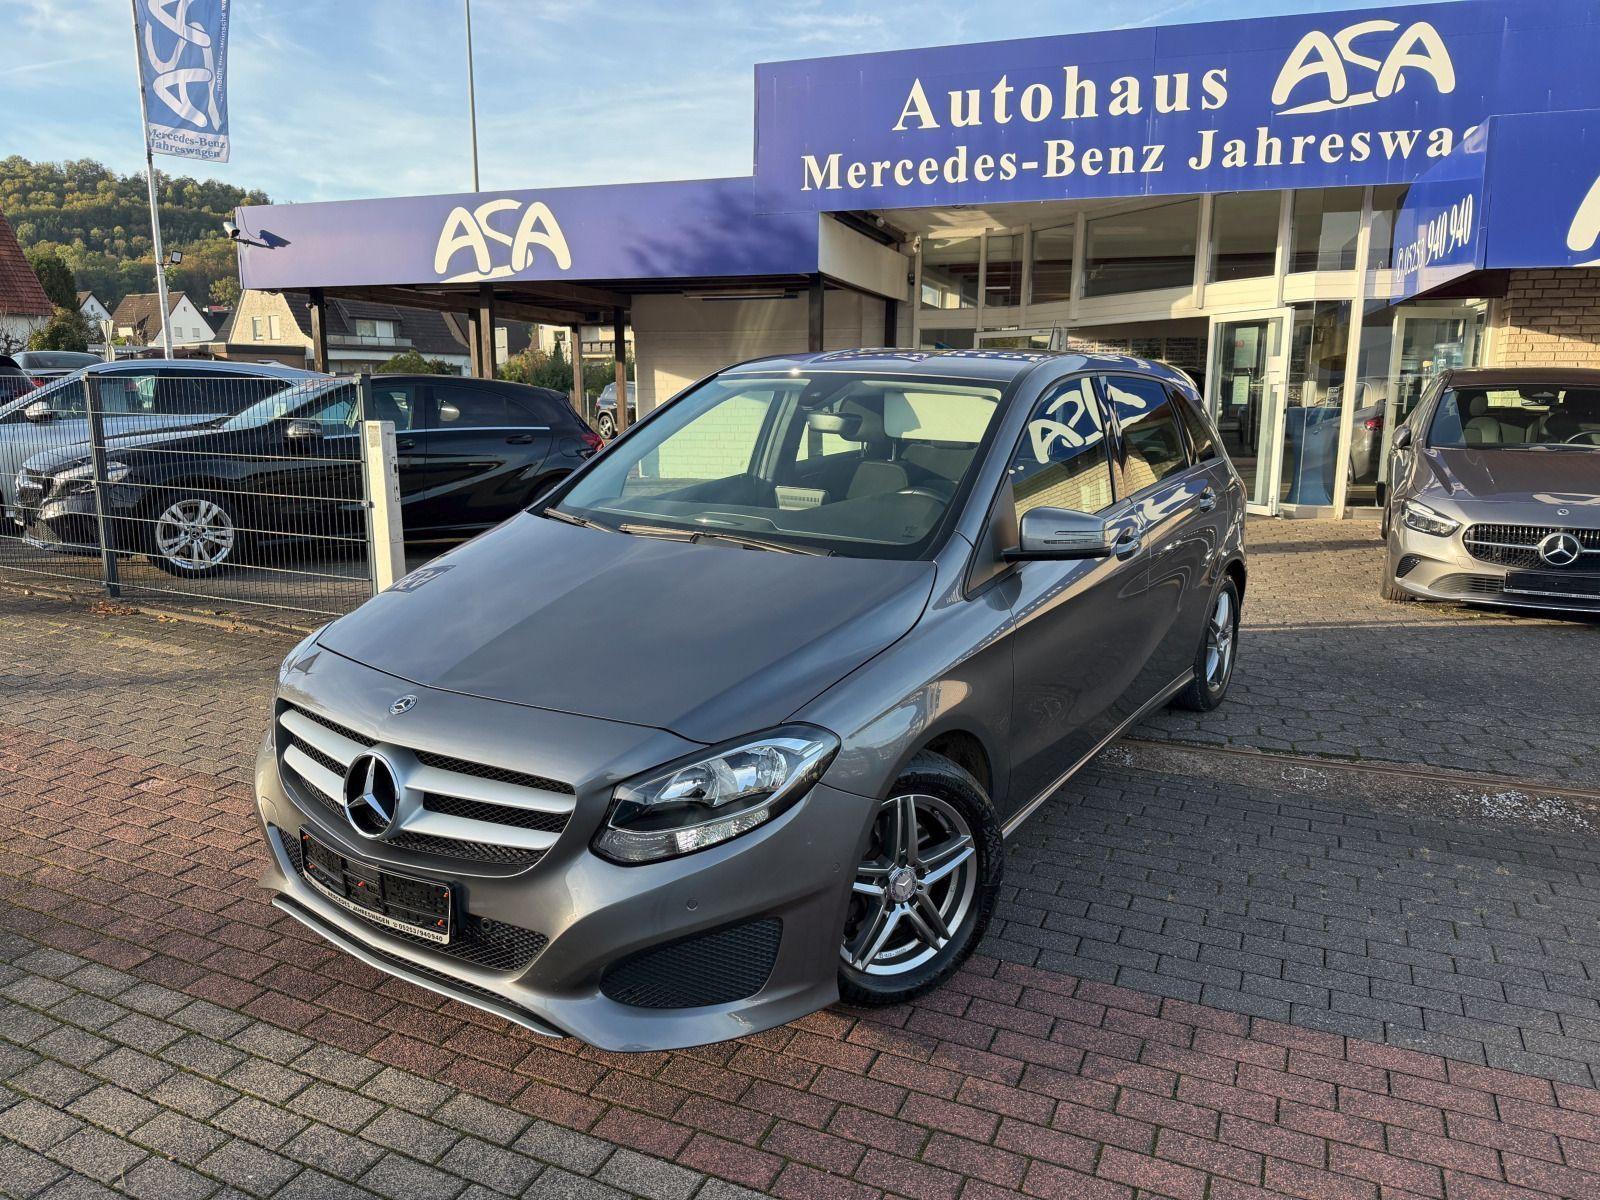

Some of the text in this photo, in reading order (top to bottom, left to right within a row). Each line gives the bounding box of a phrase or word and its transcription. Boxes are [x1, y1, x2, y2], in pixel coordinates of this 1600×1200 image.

[892, 65, 1229, 132] Autohaus
[150, 138, 220, 158] Jahreswagen
[800, 129, 1166, 193] Mercedes-Benz
[1425, 211, 1448, 265] 940
[1447, 193, 1473, 254] 940
